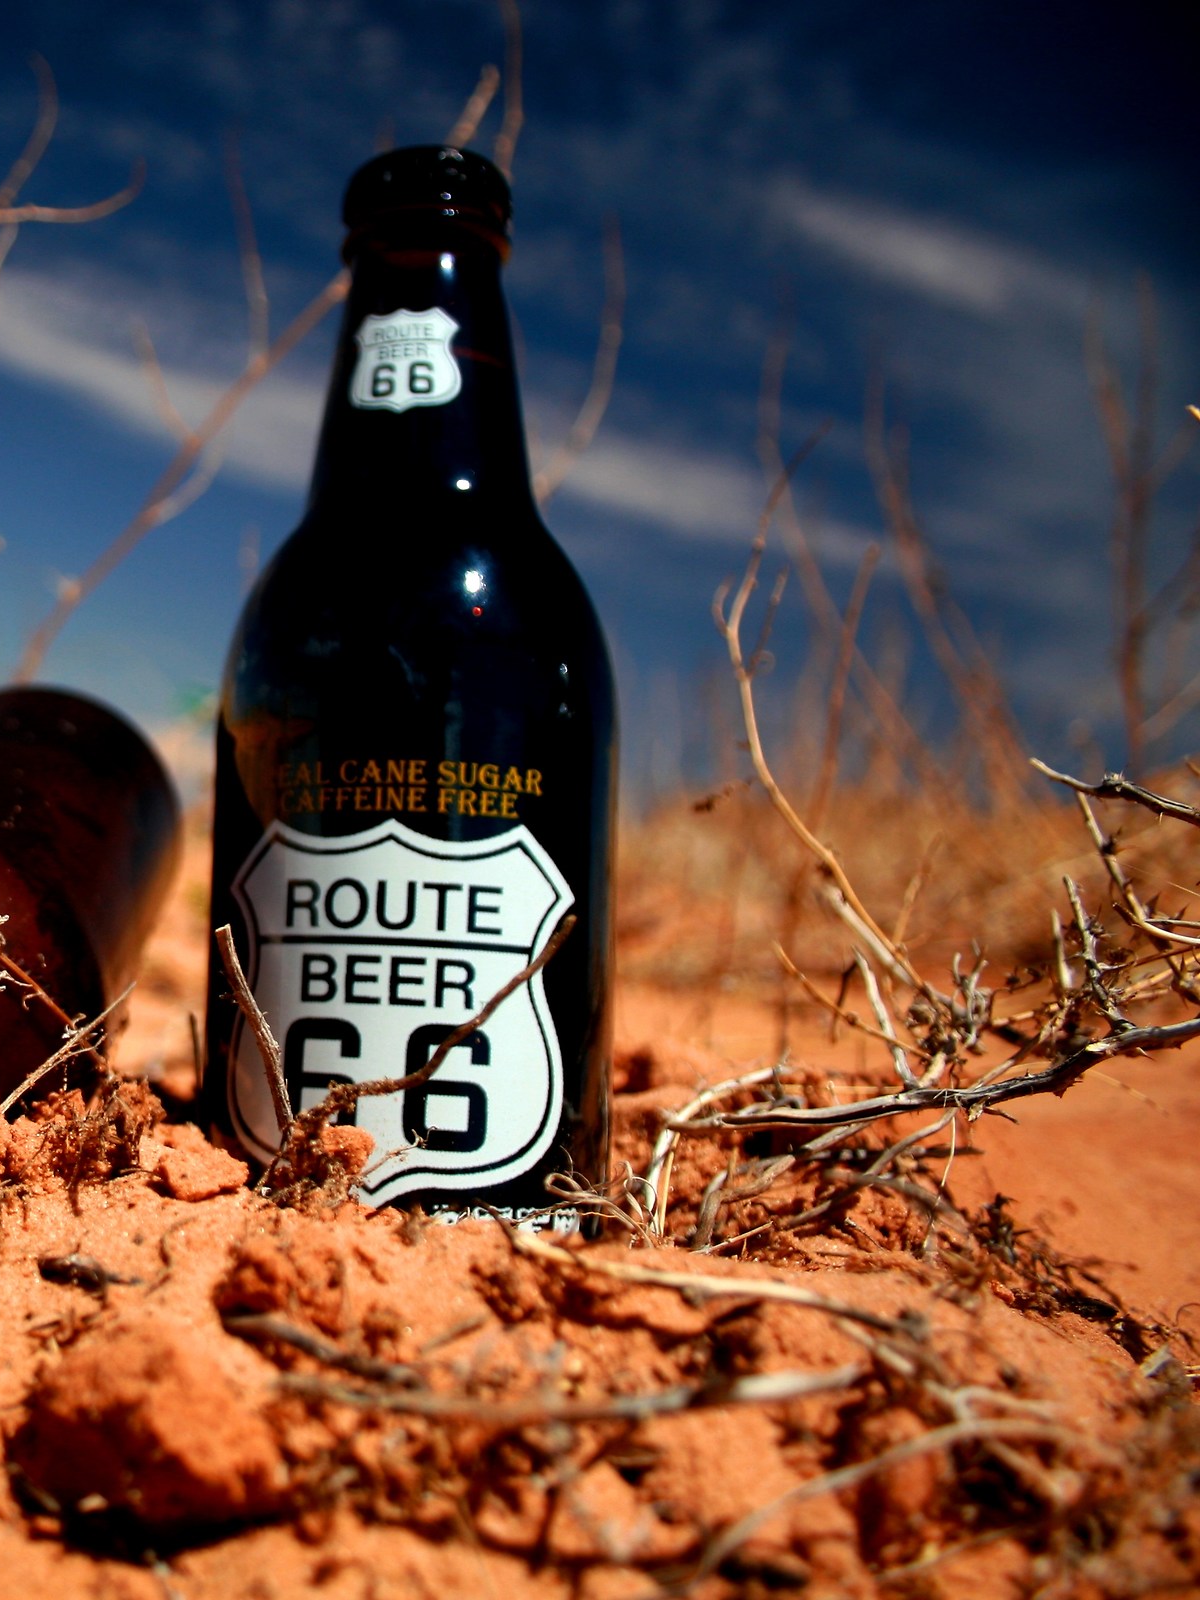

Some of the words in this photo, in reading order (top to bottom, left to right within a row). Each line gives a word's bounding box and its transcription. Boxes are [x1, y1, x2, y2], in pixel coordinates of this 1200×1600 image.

[373, 323, 434, 341] ROUTE
[377, 342, 429, 359] BEER
[371, 361, 435, 398] 66
[339, 758, 429, 786] CANE
[436, 760, 544, 797] SUGAR
[280, 786, 429, 814] CAFFEINE
[436, 788, 520, 819] FREE
[284, 877, 504, 935] ROUTE
[301, 953, 475, 1010] BEER
[284, 1016, 492, 1153] 66
